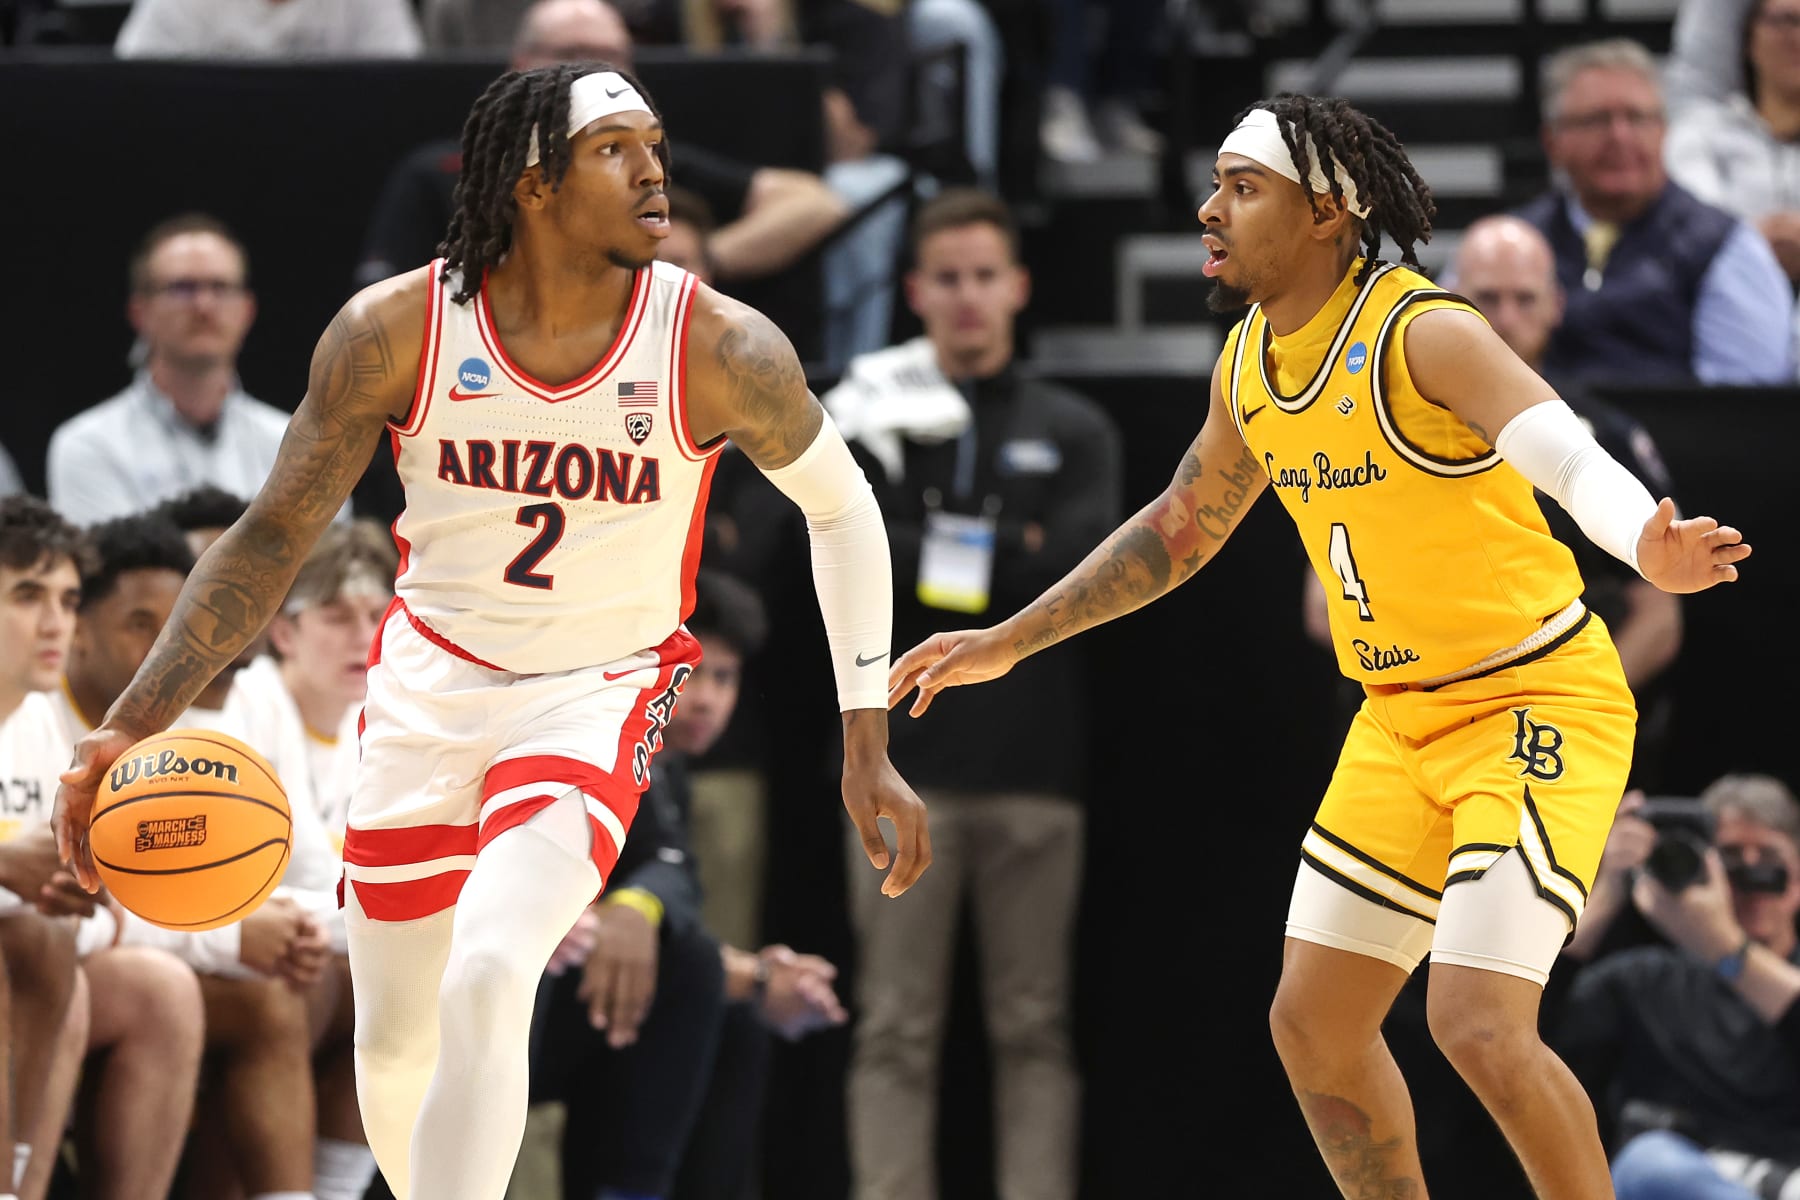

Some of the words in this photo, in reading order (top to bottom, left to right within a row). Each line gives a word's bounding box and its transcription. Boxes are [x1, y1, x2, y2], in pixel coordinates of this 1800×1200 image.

[1347, 355, 1365, 367] NCAA
[461, 371, 488, 385] NCAA
[628, 414, 652, 433] PAC
[632, 426, 646, 439] 12
[438, 439, 661, 504] ARIZONA
[1265, 452, 1312, 503] Long
[1313, 450, 1387, 490] Beach
[503, 502, 566, 590] 2
[1329, 522, 1375, 622] 4
[1352, 638, 1420, 671] State
[1509, 708, 1564, 780] LB
[110, 750, 240, 793] Wilson
[149, 819, 186, 833] MARCH
[152, 830, 206, 845] MADNESS
